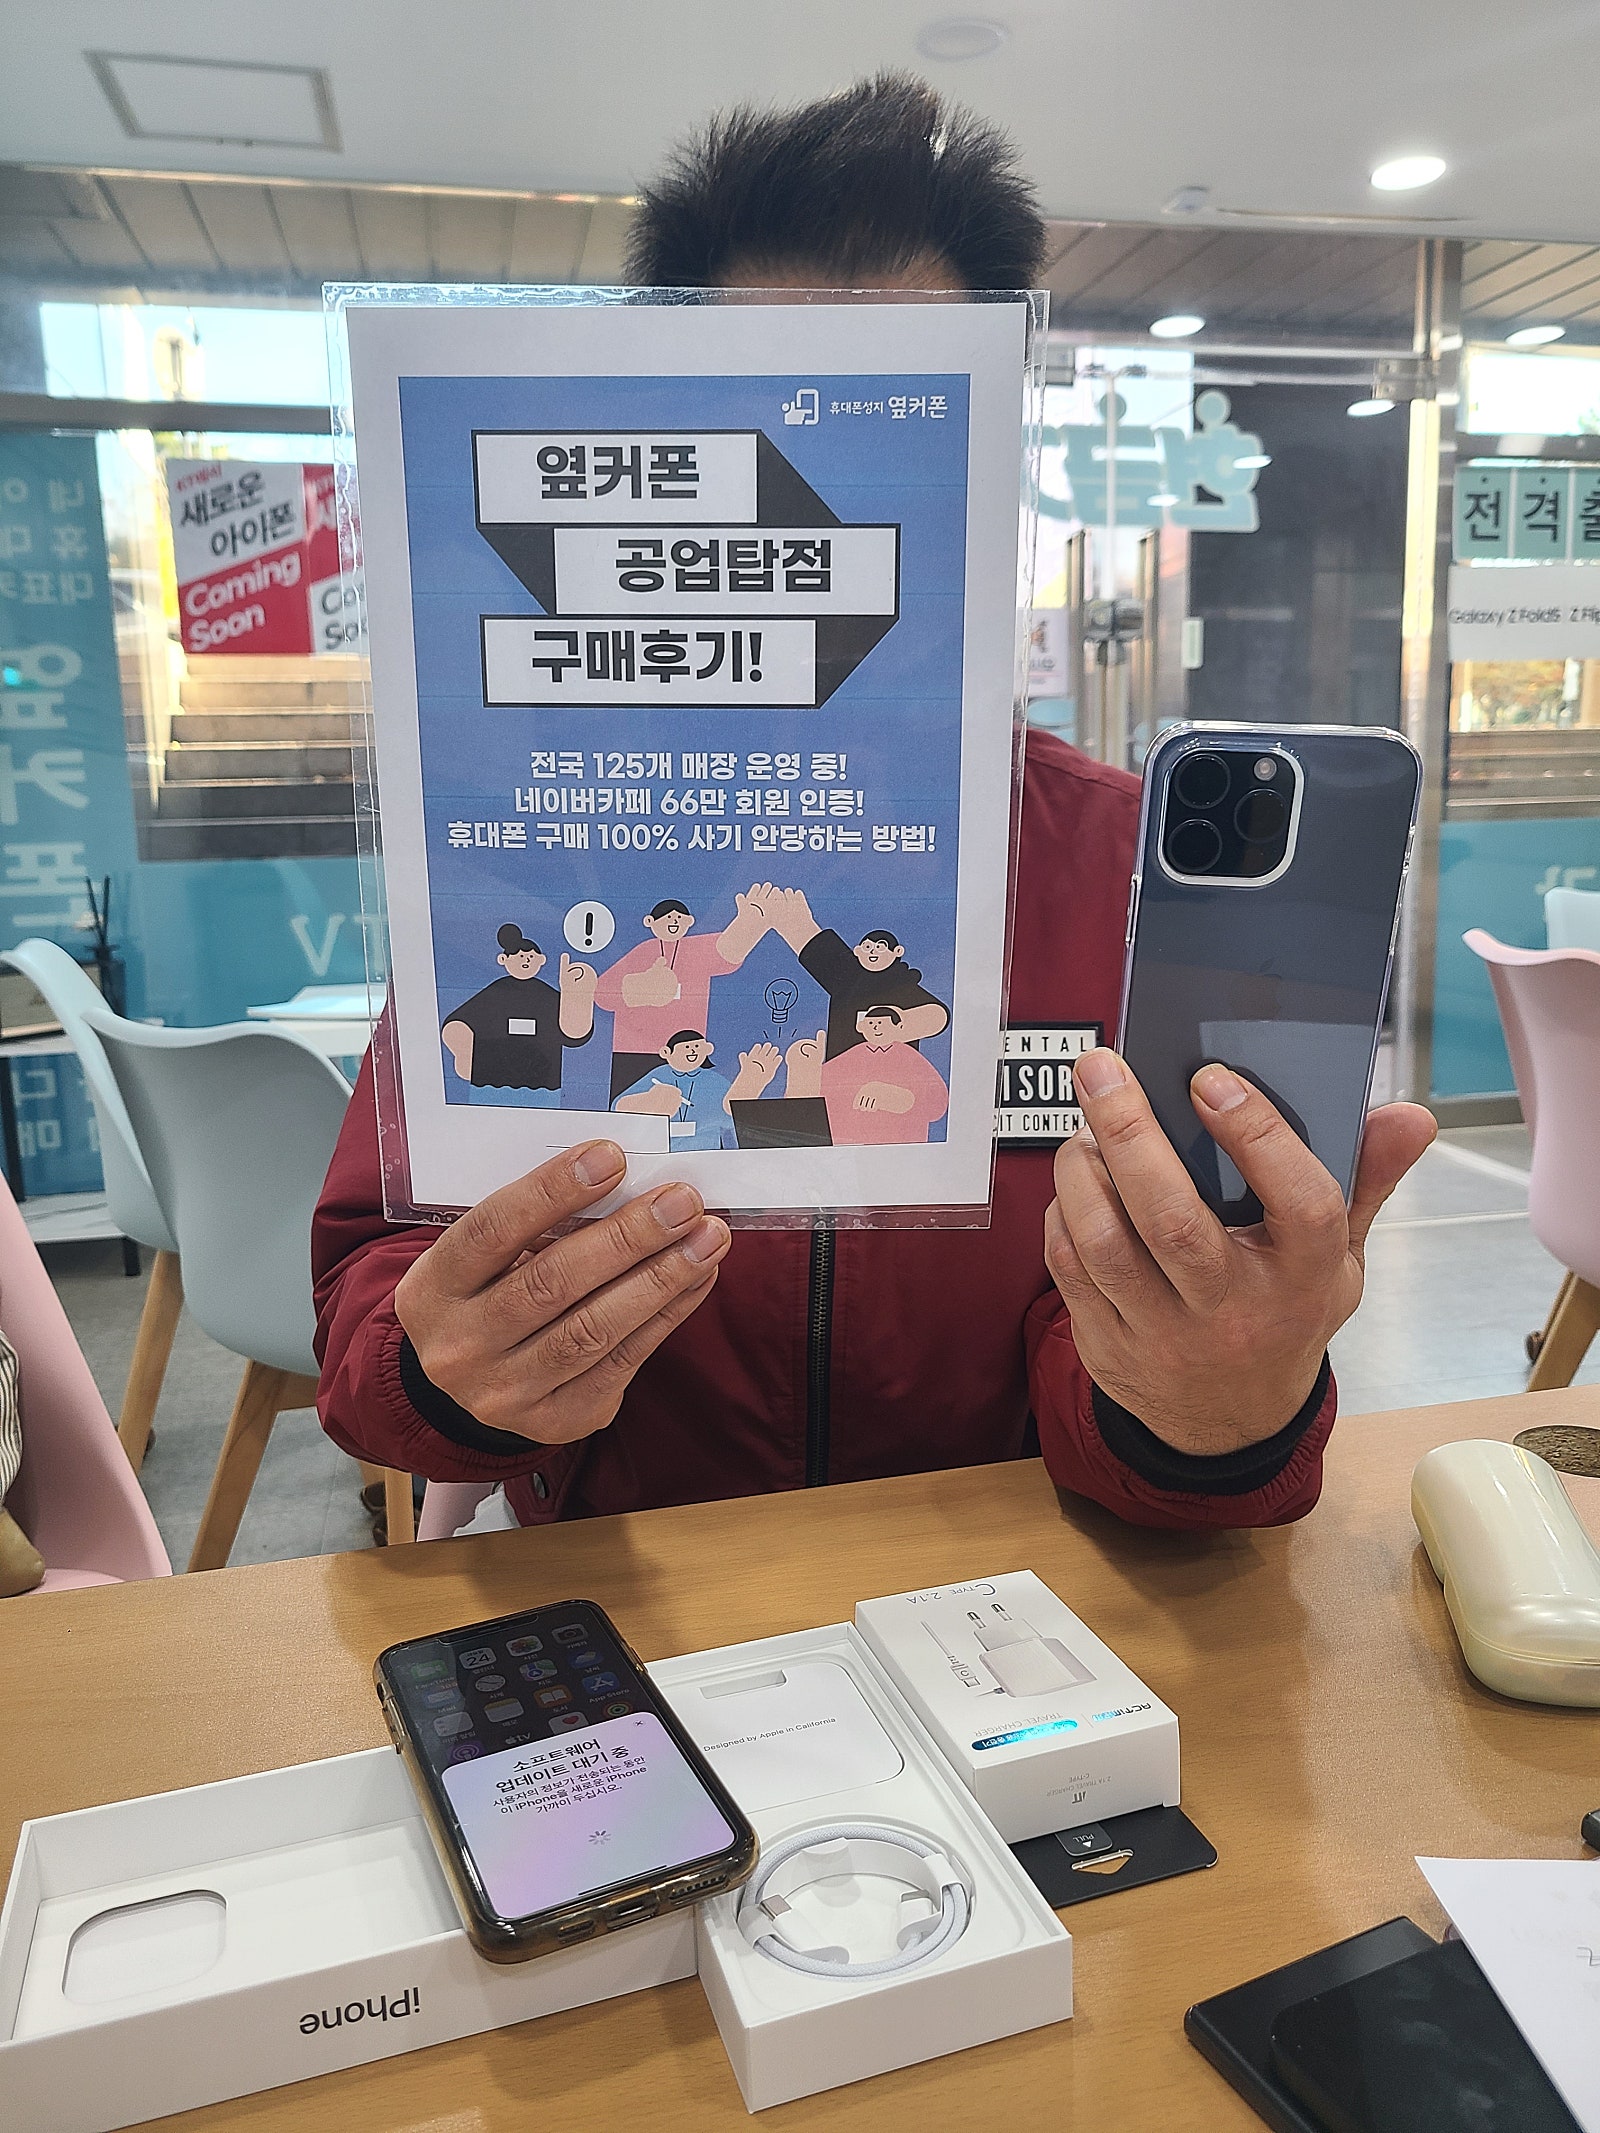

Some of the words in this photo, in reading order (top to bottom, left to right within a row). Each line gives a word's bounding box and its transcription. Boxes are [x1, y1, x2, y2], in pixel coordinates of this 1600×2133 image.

[829, 401, 884, 415] 휴대폰성지
[887, 395, 949, 419] 옆커폰
[536, 444, 701, 500] 옆커폰
[181, 470, 266, 527] 새로운
[210, 500, 296, 558] 아이폰
[615, 538, 833, 594] 공업탑점
[185, 551, 302, 618] Coming
[189, 603, 267, 652] Soon
[531, 628, 764, 685] 구매후기!
[530, 751, 585, 779] 전국
[592, 751, 672, 781] 125개
[681, 751, 738, 780] 매장
[745, 752, 802, 780] 운영
[810, 753, 848, 781] 중!
[514, 788, 652, 815] 네이버카페
[659, 788, 726, 815] 66만
[735, 788, 790, 816] 회원
[798, 789, 865, 817] 인증!
[447, 821, 527, 849] 휴대폰
[535, 822, 590, 850] 구매
[597, 823, 679, 851] 100%
[687, 824, 742, 851] 사기
[751, 825, 863, 852] 안당하는
[871, 825, 937, 853] 방법!
[906, 1591, 942, 1605] 2.1A
[466, 1653, 491, 1667] 24
[589, 1695, 606, 1703] App
[607, 1688, 630, 1698] Store
[703, 1737, 745, 1752] Designed
[746, 1734, 757, 1742] by
[759, 1728, 784, 1740] Apple
[795, 1717, 836, 1731] California
[974, 1720, 1023, 1738] CHARGER
[1024, 1712, 1064, 1725] TRAVEL
[495, 1763, 570, 1794] 업데이트
[572, 1751, 609, 1771] 대기
[611, 1745, 629, 1759] 중
[513, 1738, 601, 1773] 소프트웨어
[493, 1787, 539, 1807] 사용자의
[541, 1777, 575, 1793] 정보가
[576, 1764, 621, 1782] 전송되는
[623, 1756, 646, 1768] 동안
[500, 1803, 513, 1814] 이
[515, 1789, 568, 1811] iPhone을
[571, 1778, 604, 1794] 새로운
[606, 1766, 647, 1783] iPhone
[536, 1797, 572, 1814] 가까이
[573, 1784, 623, 1802] 두십시오.
[1072, 1833, 1095, 1843] PULL
[298, 1985, 422, 2038] iPhone
